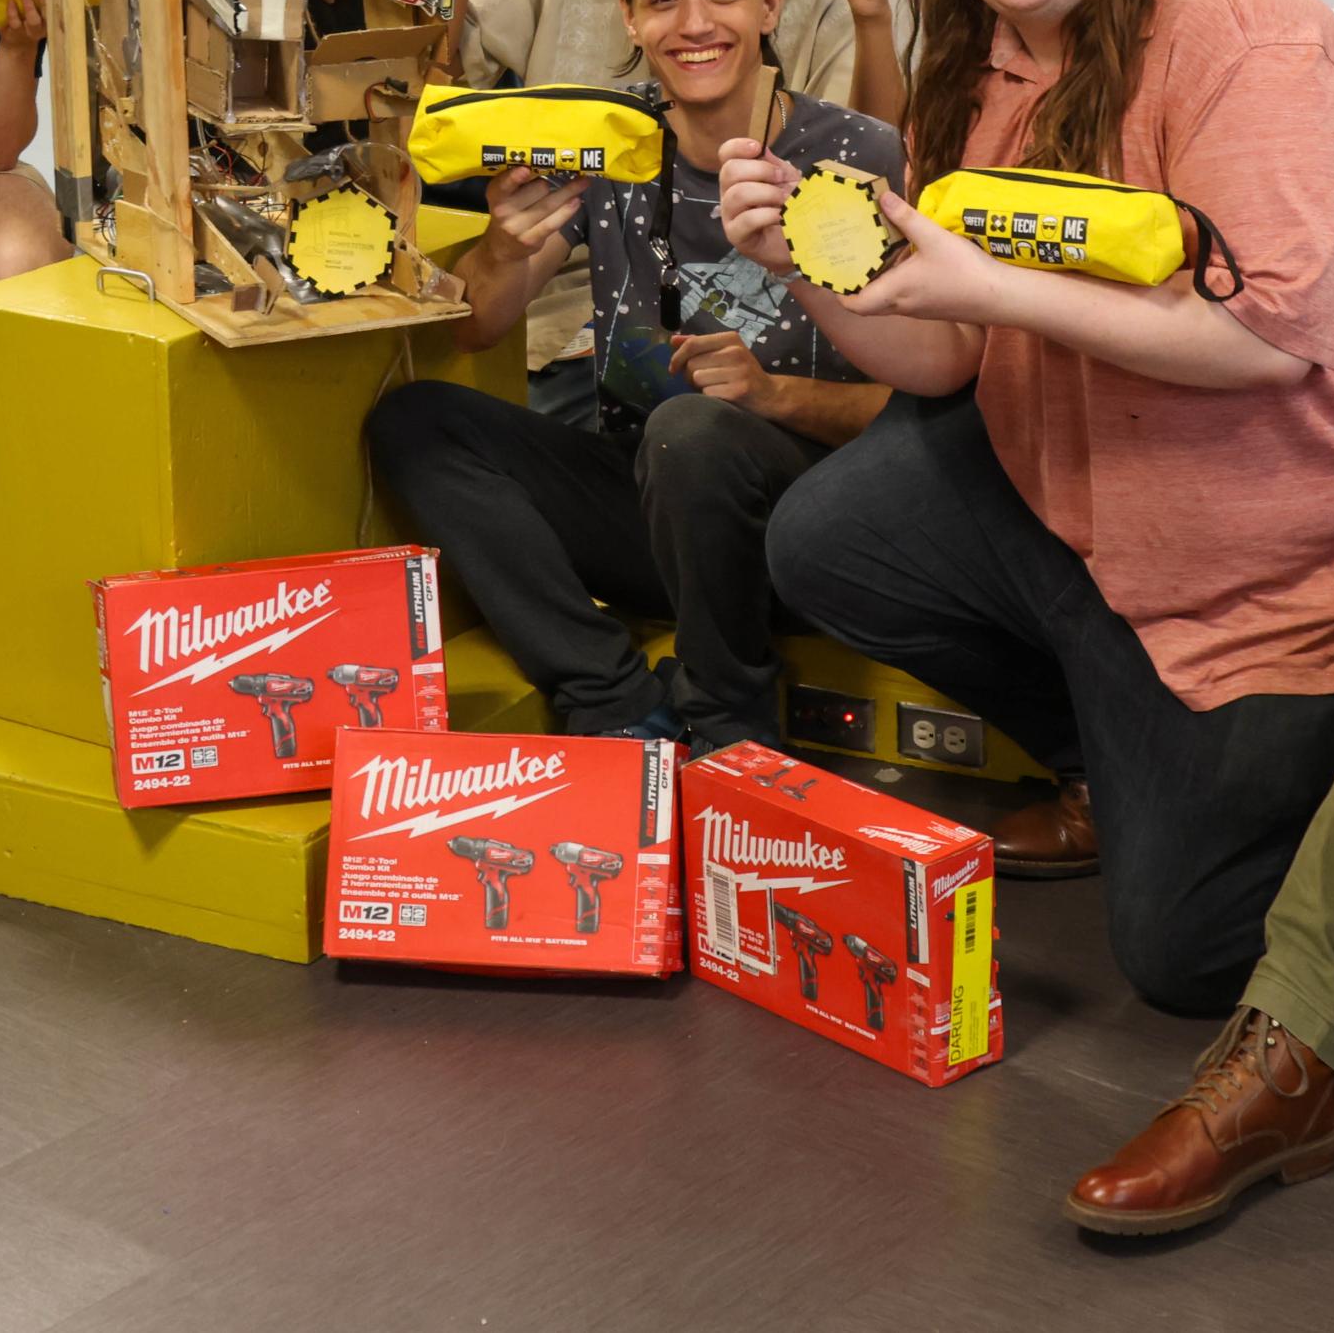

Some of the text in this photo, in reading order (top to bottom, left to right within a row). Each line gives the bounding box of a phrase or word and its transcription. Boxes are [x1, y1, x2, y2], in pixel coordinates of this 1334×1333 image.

[483, 150, 602, 169] SAFETY TECH ME
[963, 215, 1085, 240] SAFETY TECH ME
[989, 241, 1011, 255] GWW
[123, 581, 333, 674] Milwaukee
[154, 707, 183, 715] 2-Tool
[129, 715, 162, 725] Combo
[129, 725, 159, 734] Juego
[160, 719, 211, 731] combinado
[131, 739, 175, 749] Ensemble
[177, 737, 189, 745] de
[201, 732, 225, 742] outils
[139, 727, 201, 739] herramientas
[135, 754, 181, 771] M12
[134, 775, 191, 791] 2494-22
[348, 747, 565, 819] Milwaukee
[693, 805, 847, 871] Milwaukee
[343, 863, 375, 871] Combo
[368, 857, 397, 865] 2-Tool
[341, 873, 439, 883] Juego combinado de
[349, 881, 413, 890] herramientas
[932, 858, 980, 899] Milwaukee
[341, 889, 385, 897] Ensemble
[411, 891, 437, 899] outils
[343, 905, 390, 920] M12
[338, 927, 396, 941] 2494-22
[699, 957, 740, 983] 2494-22
[951, 985, 964, 1063] DARLING
